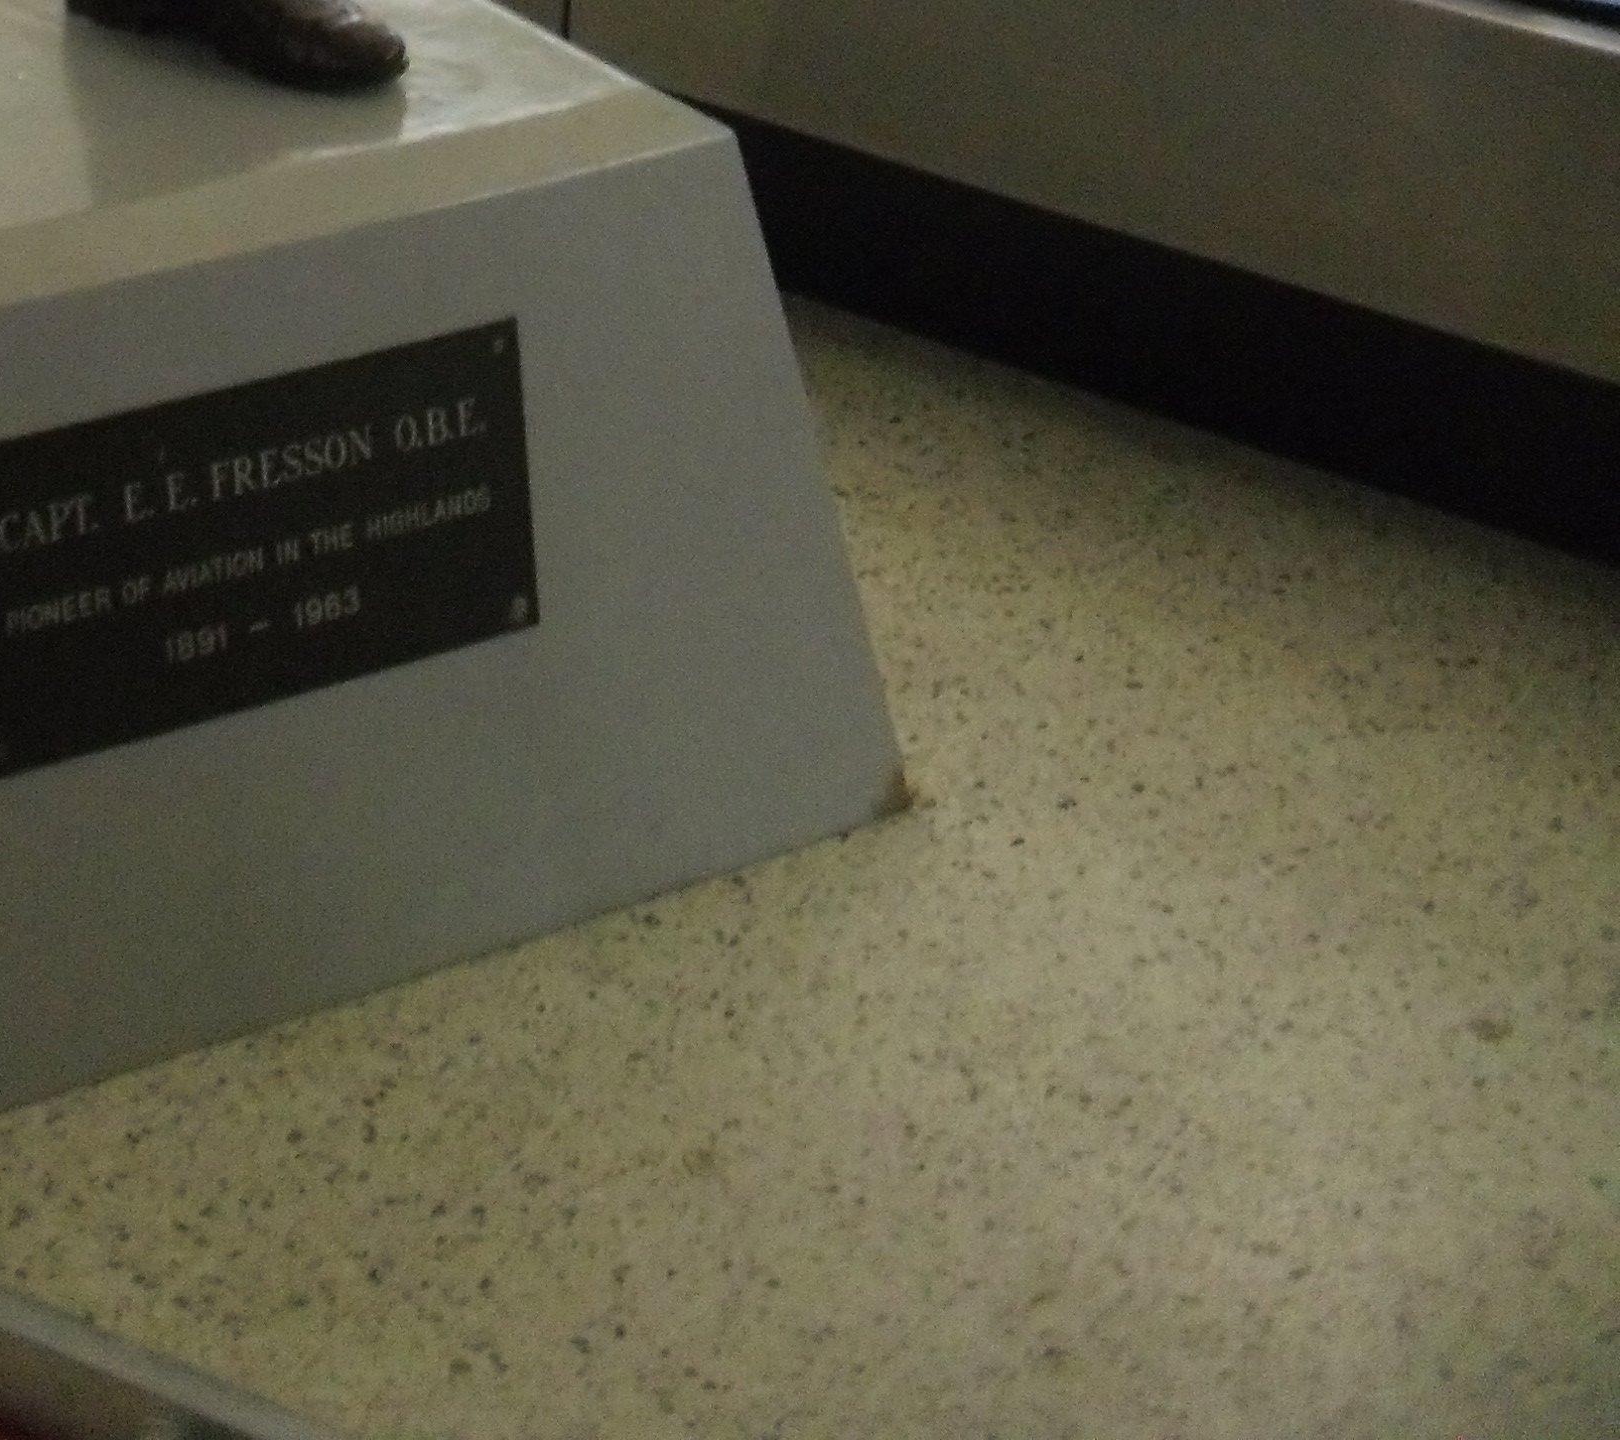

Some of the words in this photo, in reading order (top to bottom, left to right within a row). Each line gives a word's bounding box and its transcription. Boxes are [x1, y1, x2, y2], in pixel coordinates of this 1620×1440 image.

[122, 481, 155, 523] E.
[165, 471, 199, 512] E.
[209, 423, 374, 501] FRESSON
[5, 584, 112, 636] PIONEER
[121, 575, 152, 606] OF
[163, 544, 265, 594] AVIATION
[276, 537, 301, 567] IN
[310, 522, 355, 556] THE
[365, 483, 492, 541] HIGHLANDS
[165, 623, 228, 665] 1891
[292, 585, 362, 630] 1963
